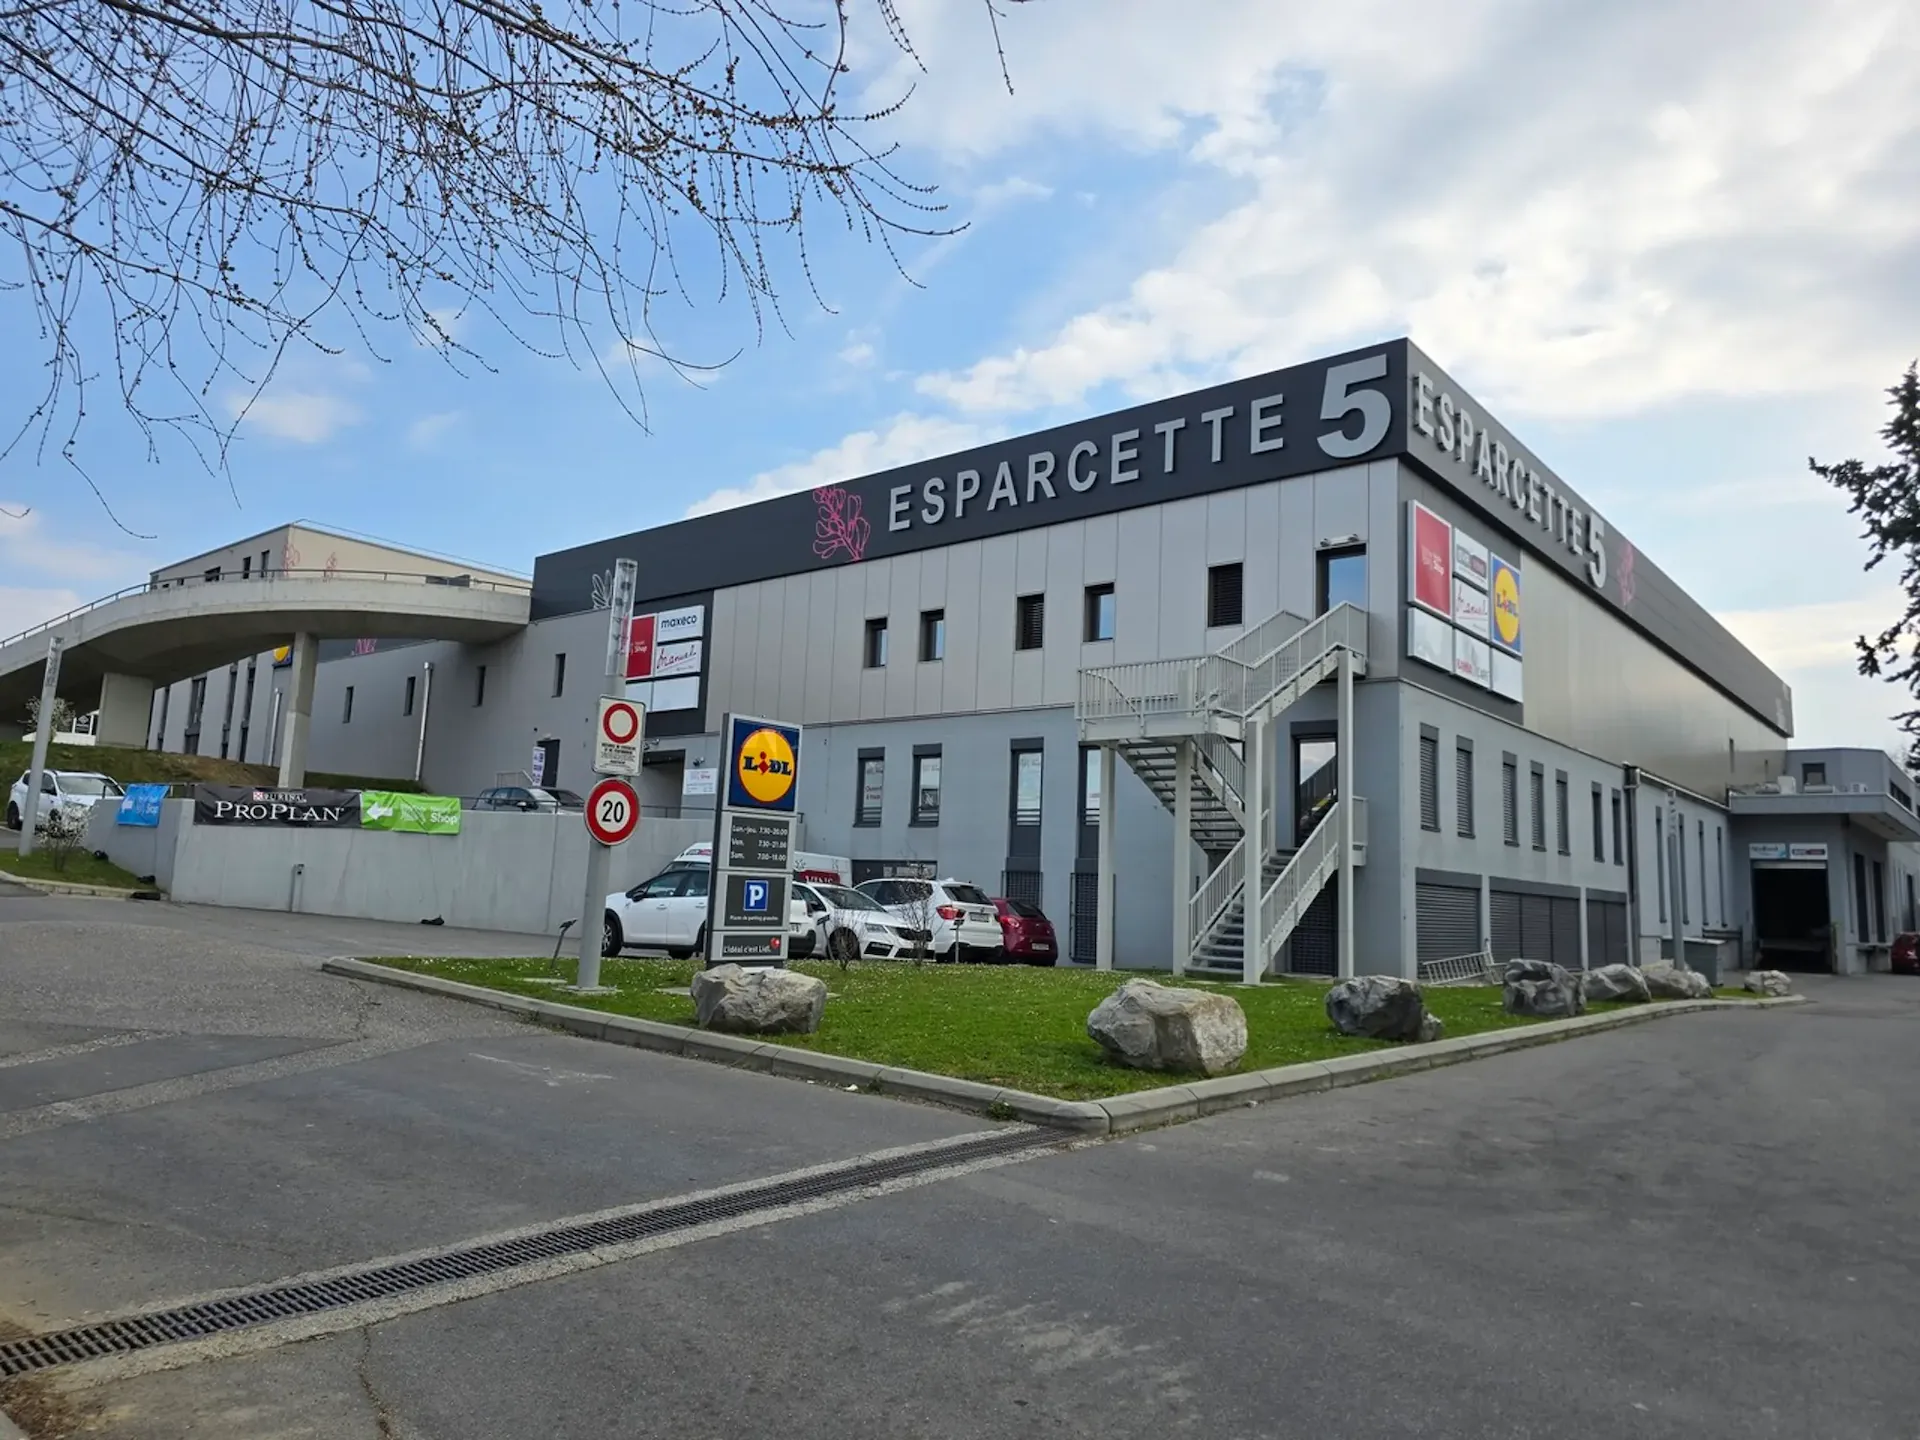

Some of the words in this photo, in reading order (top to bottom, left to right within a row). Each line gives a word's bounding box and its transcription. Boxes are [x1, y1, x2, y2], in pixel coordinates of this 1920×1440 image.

[888, 393, 1284, 532] ESPARCETTE
[1317, 353, 1392, 458] 5
[1413, 371, 1583, 556] ESPARCETTE
[1586, 510, 1607, 588] 5
[660, 615, 698, 629] maxeco
[430, 812, 457, 825] Shop
[601, 800, 624, 823] 20
[749, 885, 764, 907] P
